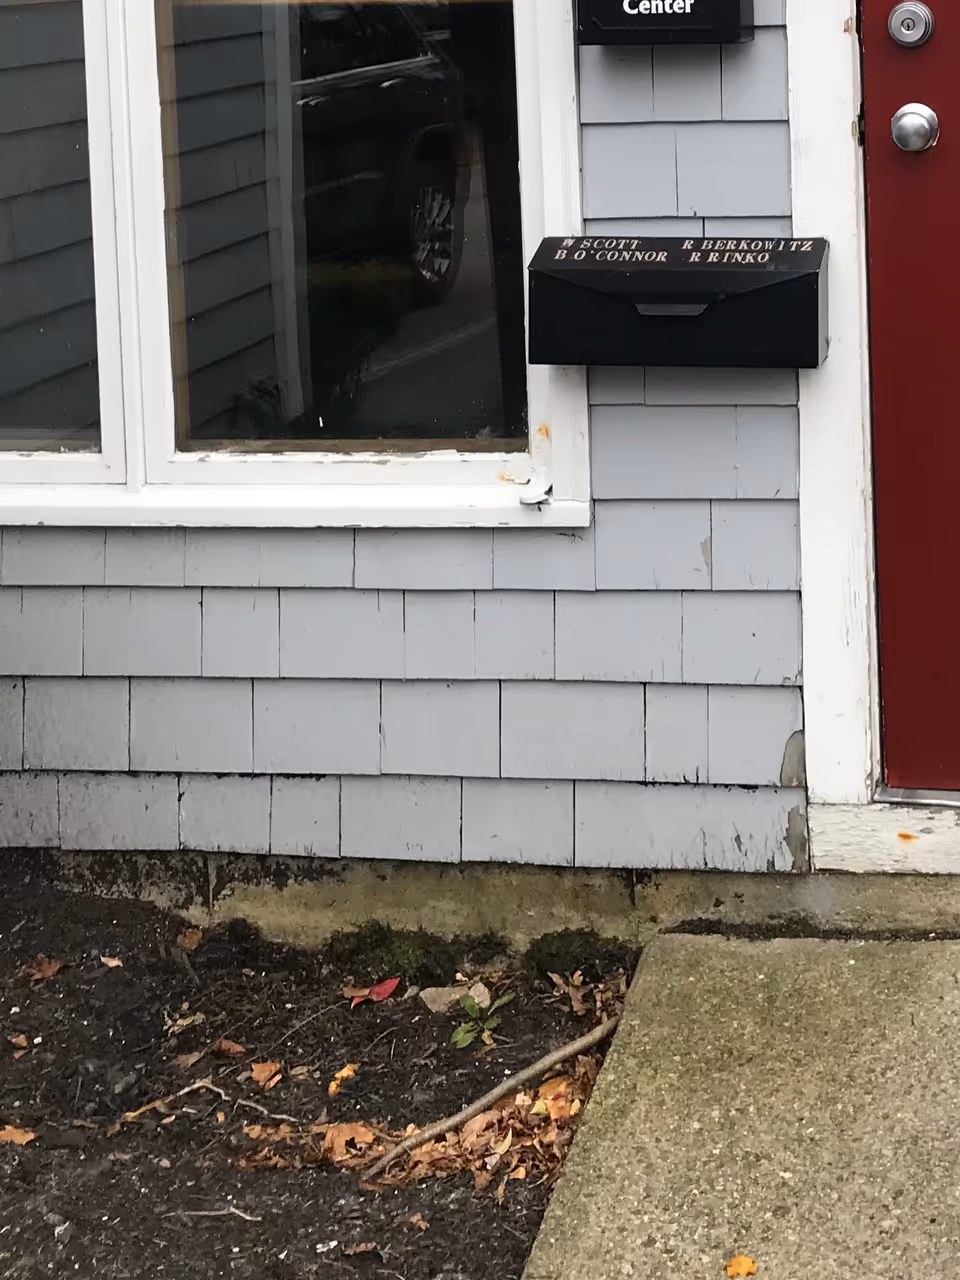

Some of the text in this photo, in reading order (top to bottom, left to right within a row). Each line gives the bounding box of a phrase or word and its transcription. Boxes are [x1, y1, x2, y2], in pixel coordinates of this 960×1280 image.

[580, 238, 641, 249] SCOTT
[682, 239, 694, 250] R
[554, 249, 568, 260] B
[689, 251, 701, 263] R
